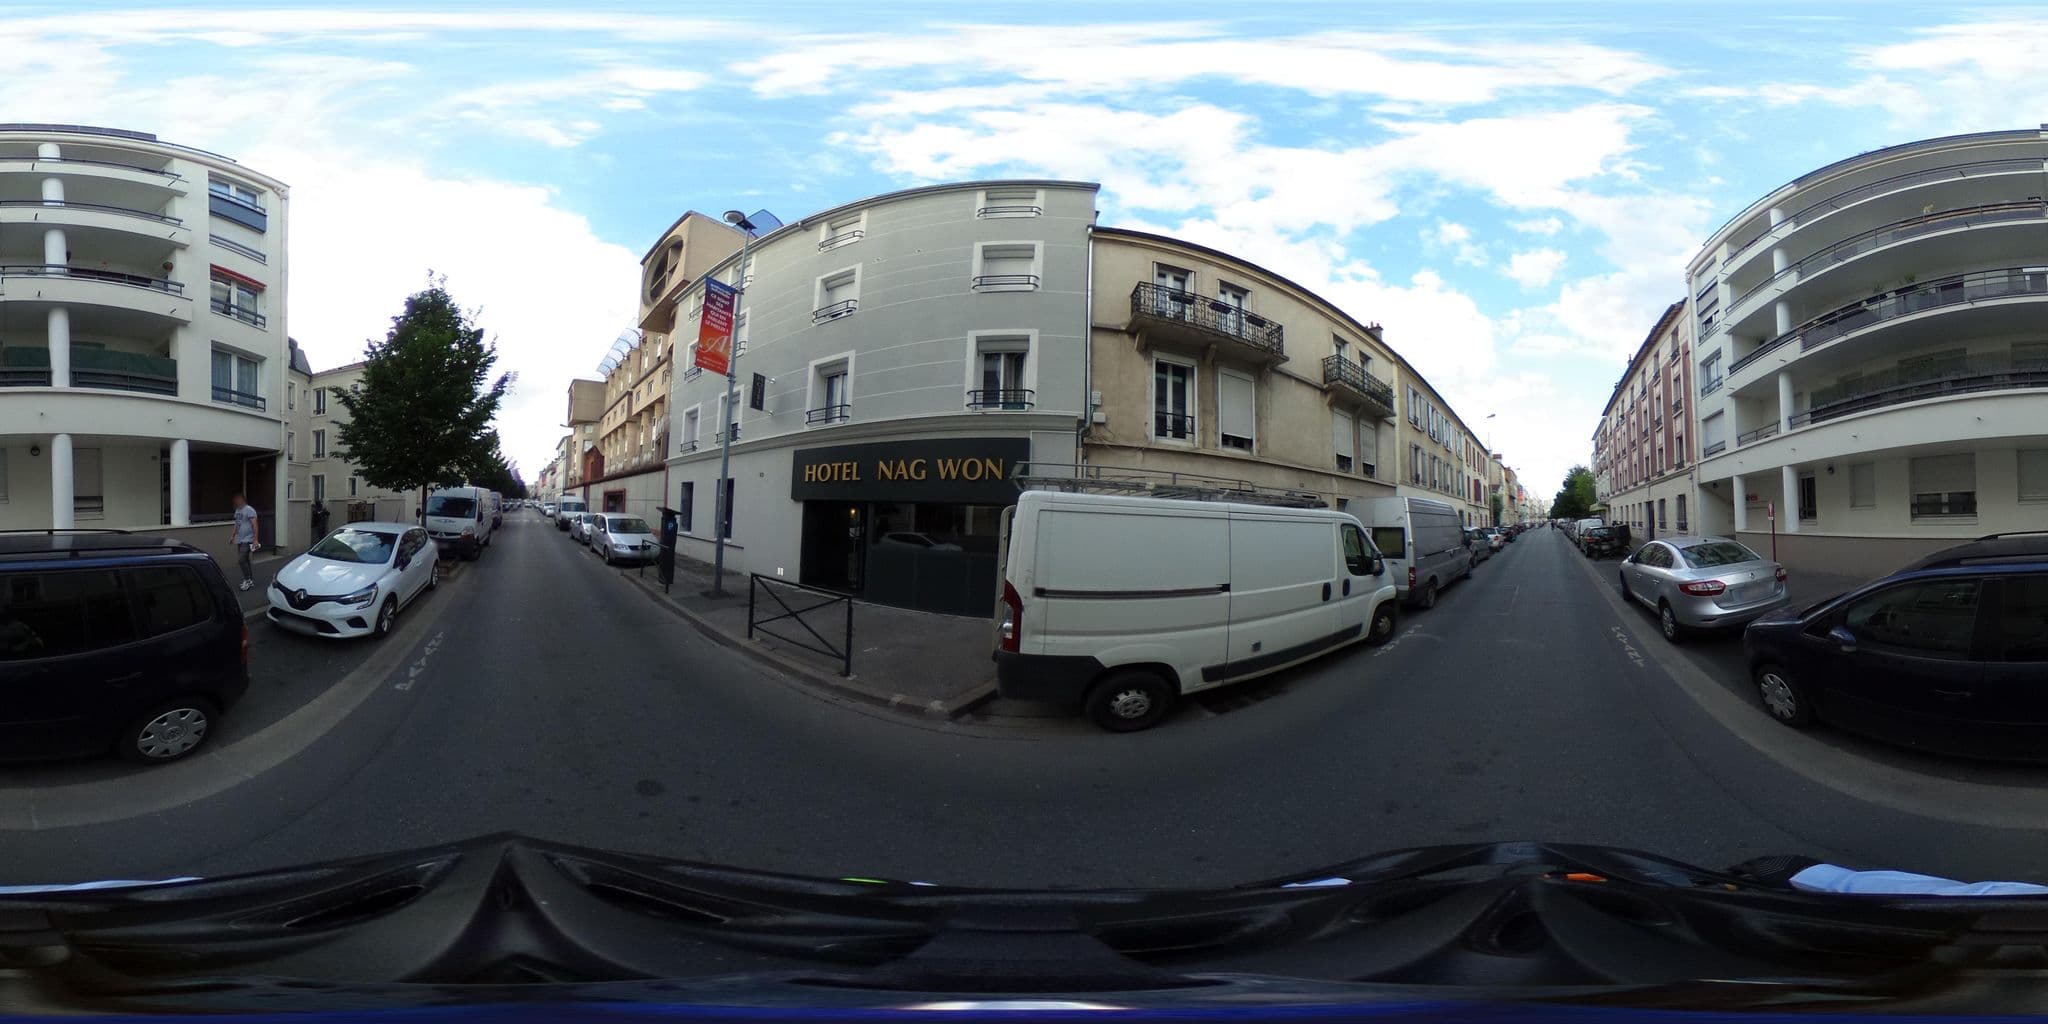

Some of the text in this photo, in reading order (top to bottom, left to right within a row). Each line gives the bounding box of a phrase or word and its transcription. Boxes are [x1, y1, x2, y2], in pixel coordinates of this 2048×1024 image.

[804, 458, 1003, 482] HOTEL NAG WON
